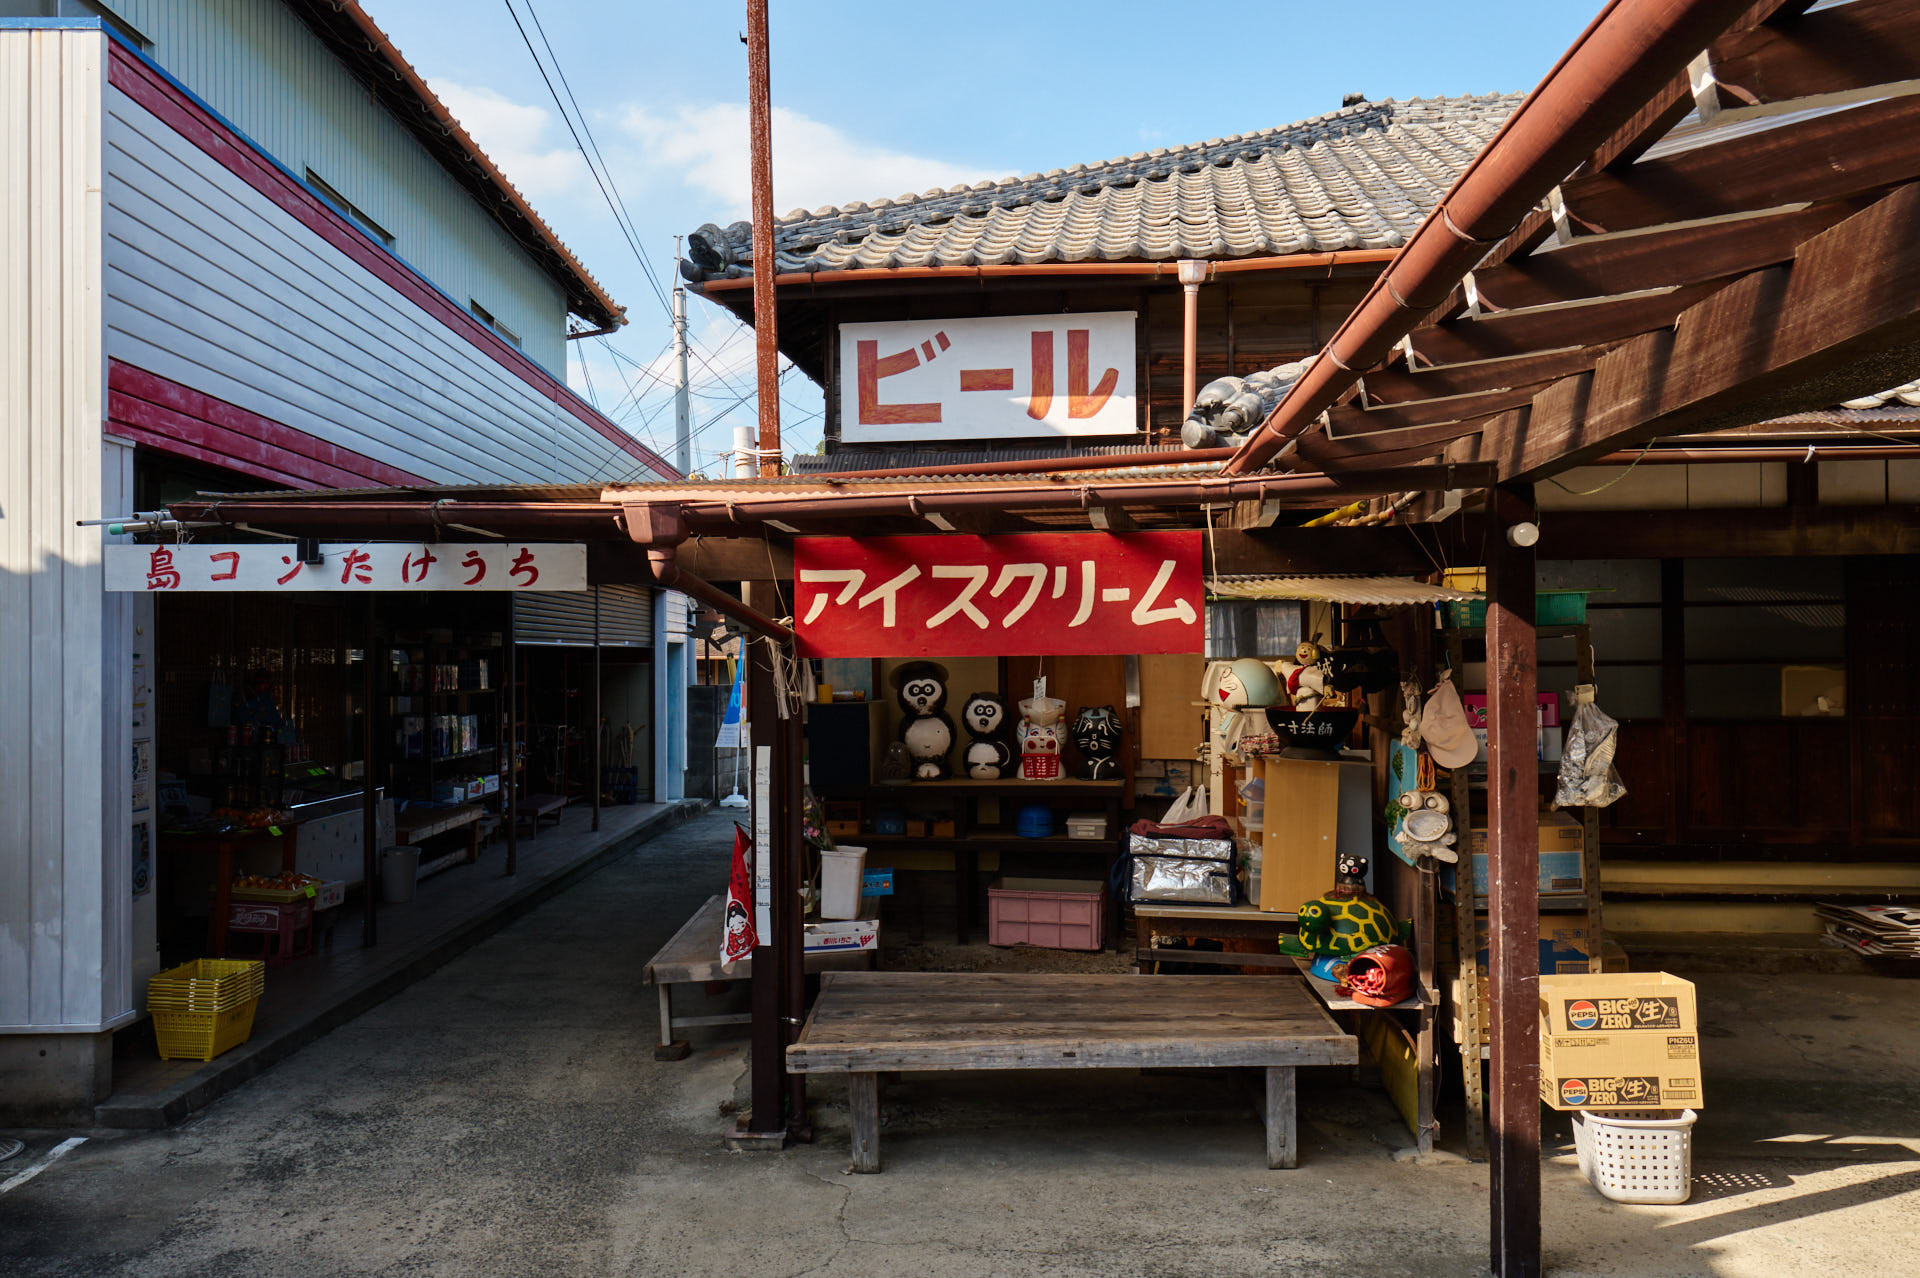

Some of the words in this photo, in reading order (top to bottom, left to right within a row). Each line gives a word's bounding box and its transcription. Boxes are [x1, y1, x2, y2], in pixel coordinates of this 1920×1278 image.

[857, 329, 1119, 425] ビール
[799, 559, 1197, 629] アイスクリーム
[1278, 720, 1333, 736] 一寸法師
[1598, 1000, 1630, 1014] BIG
[1600, 1014, 1631, 1029] ZERO
[1588, 1079, 1617, 1092] BIG
[1589, 1092, 1617, 1105] ZERO
